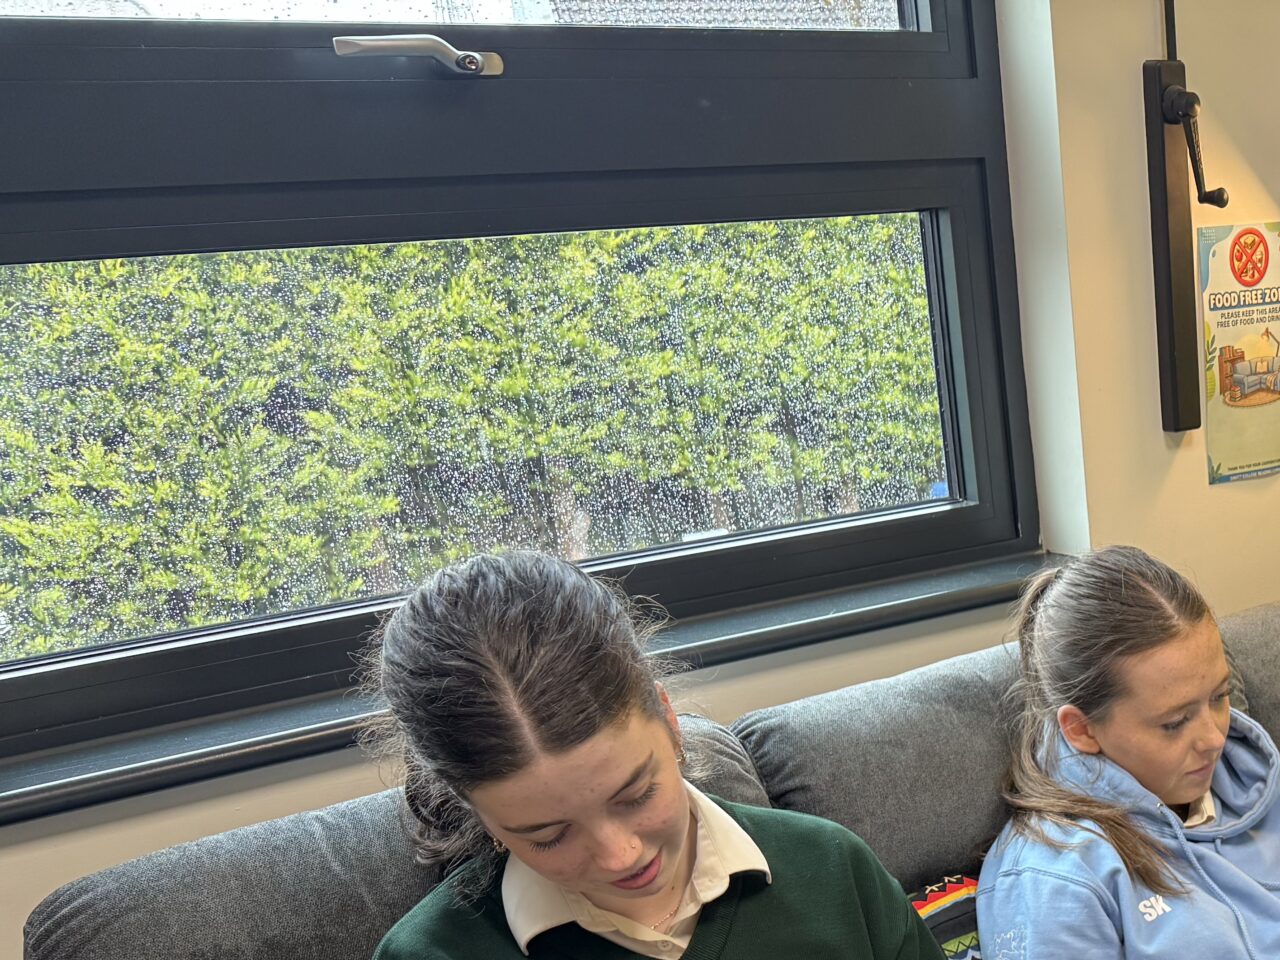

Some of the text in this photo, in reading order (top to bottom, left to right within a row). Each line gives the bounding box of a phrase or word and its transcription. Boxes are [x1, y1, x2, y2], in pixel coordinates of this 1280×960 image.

[1209, 292, 1239, 309] FOOD
[1240, 289, 1263, 306] FREE
[1220, 311, 1241, 320] PLEASE
[1242, 309, 1255, 317] KEEP
[1231, 319, 1239, 327] OF
[1240, 317, 1255, 326] FOOD
[1256, 315, 1267, 323] AND
[1138, 894, 1173, 922] SK
